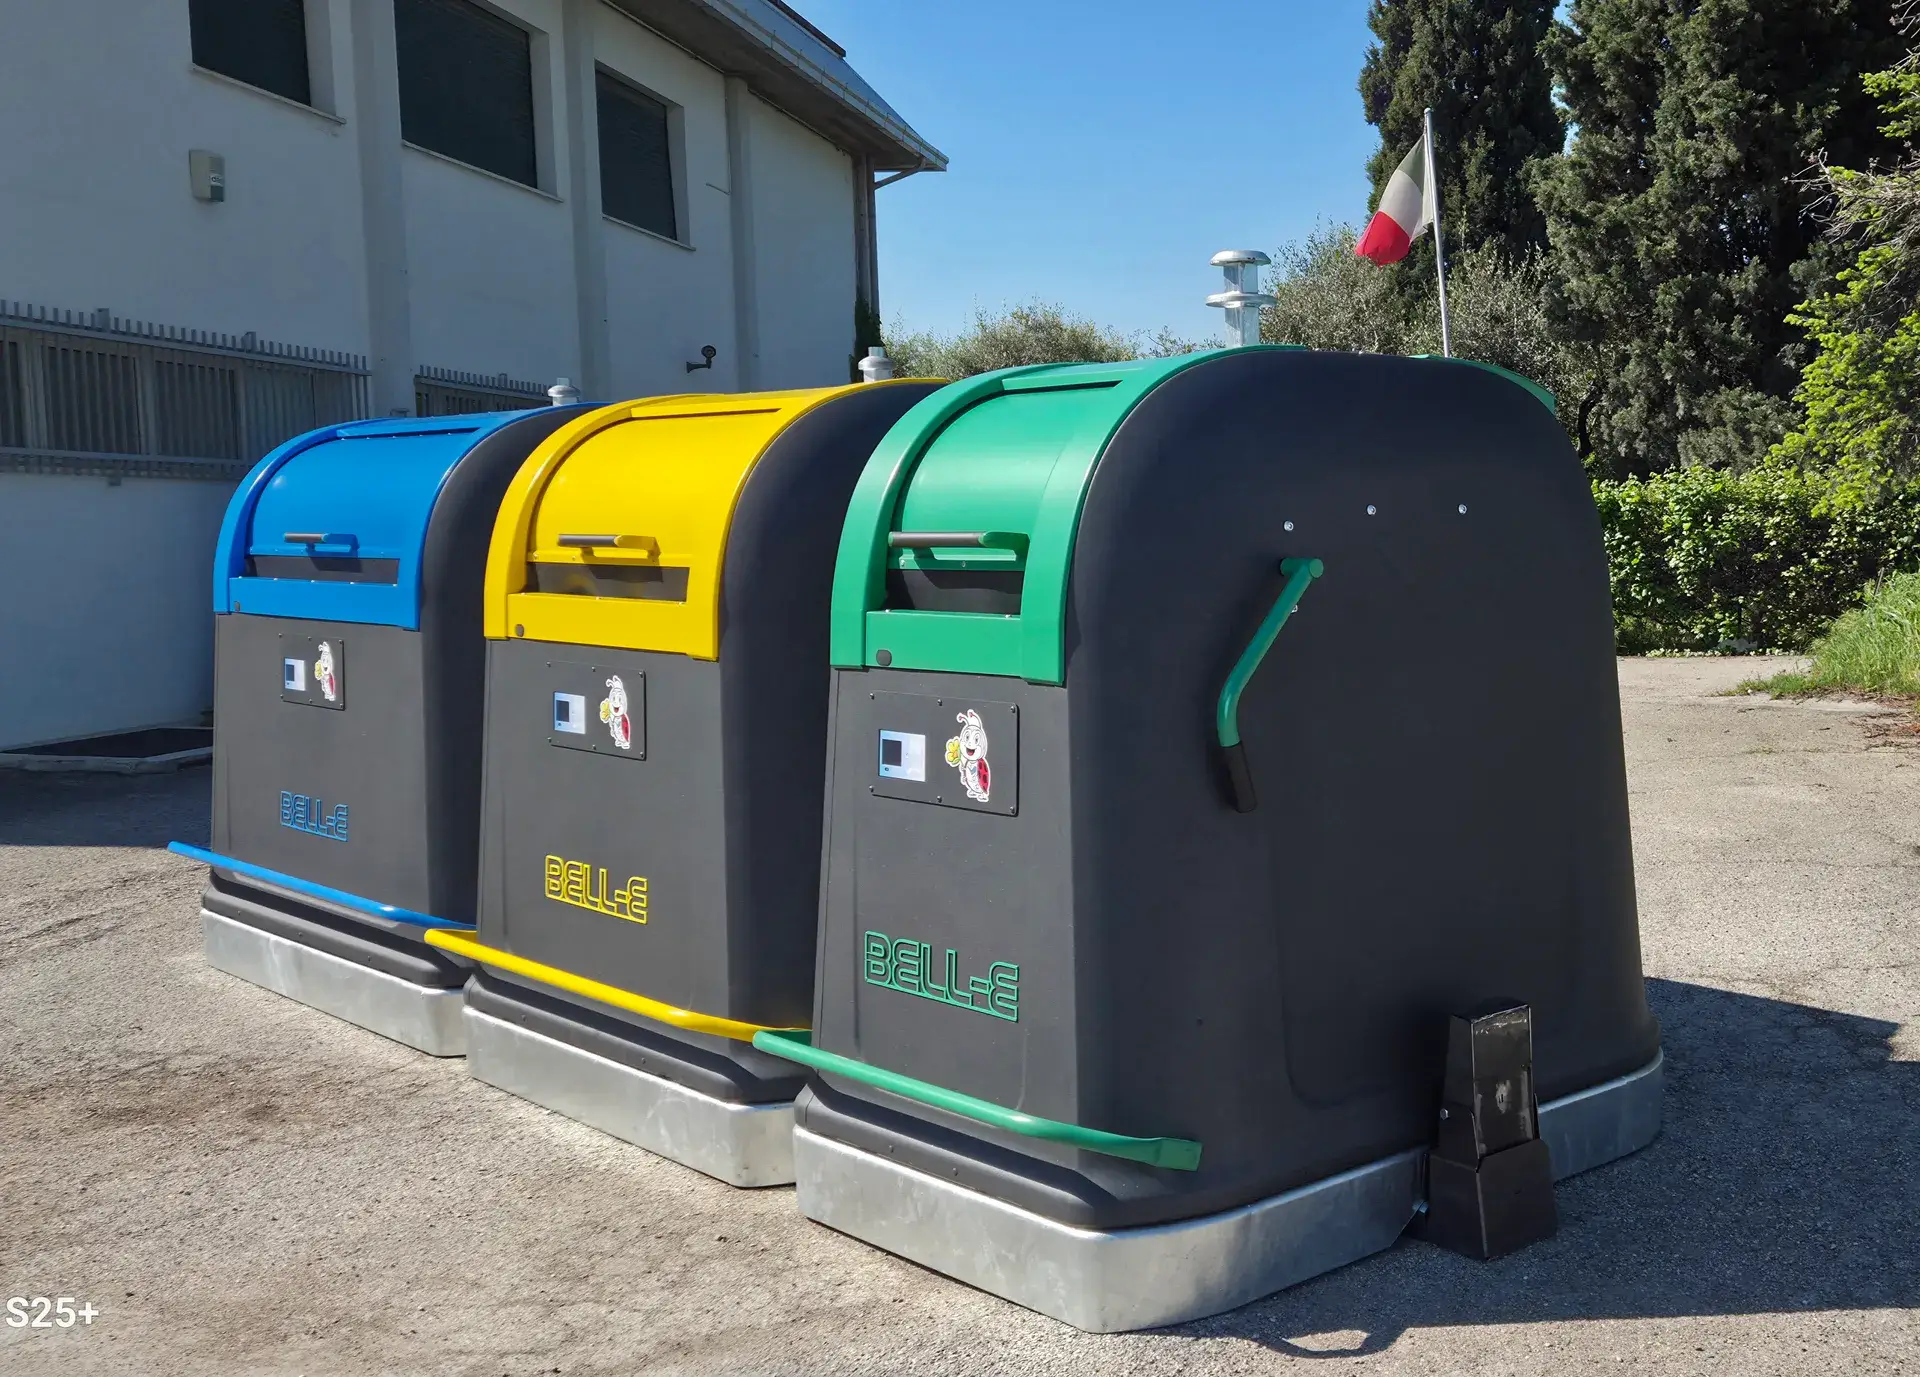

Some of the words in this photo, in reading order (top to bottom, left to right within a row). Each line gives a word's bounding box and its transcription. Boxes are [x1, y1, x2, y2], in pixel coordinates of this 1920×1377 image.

[280, 790, 347, 842] BELL-E
[545, 854, 648, 925] BELL-E
[864, 930, 1019, 1023] BELL-E
